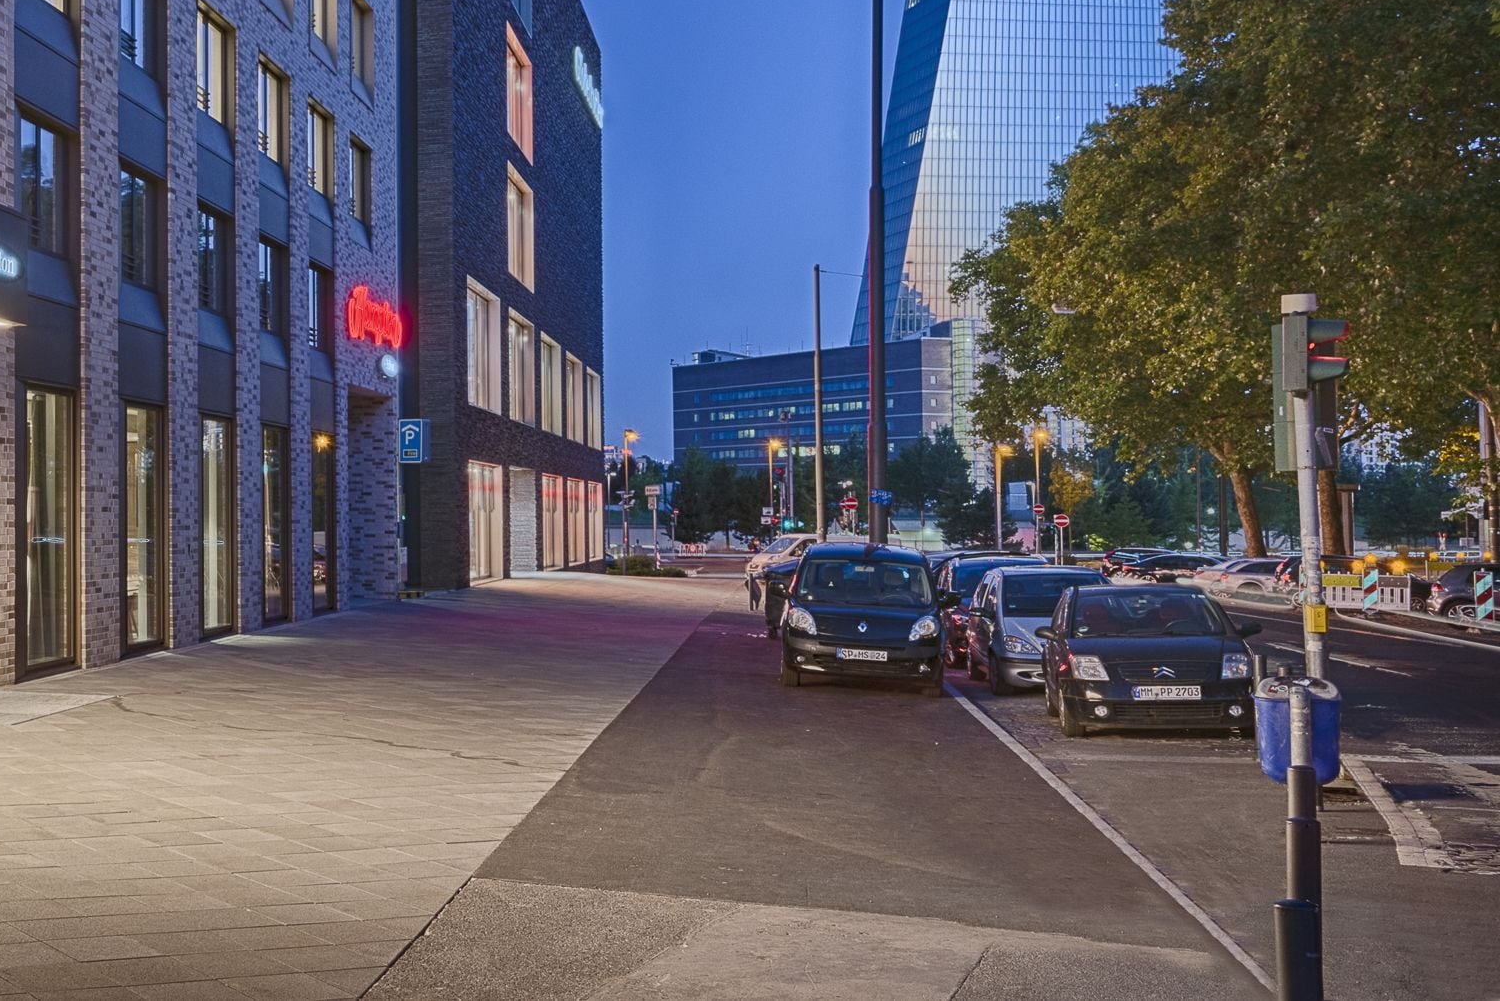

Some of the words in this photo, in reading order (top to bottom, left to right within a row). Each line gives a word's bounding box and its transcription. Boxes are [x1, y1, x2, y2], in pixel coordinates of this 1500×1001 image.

[405, 430, 415, 445] P
[1140, 687, 1153, 696] MM
[1160, 687, 1173, 697] PP
[1175, 687, 1200, 697] 2703
